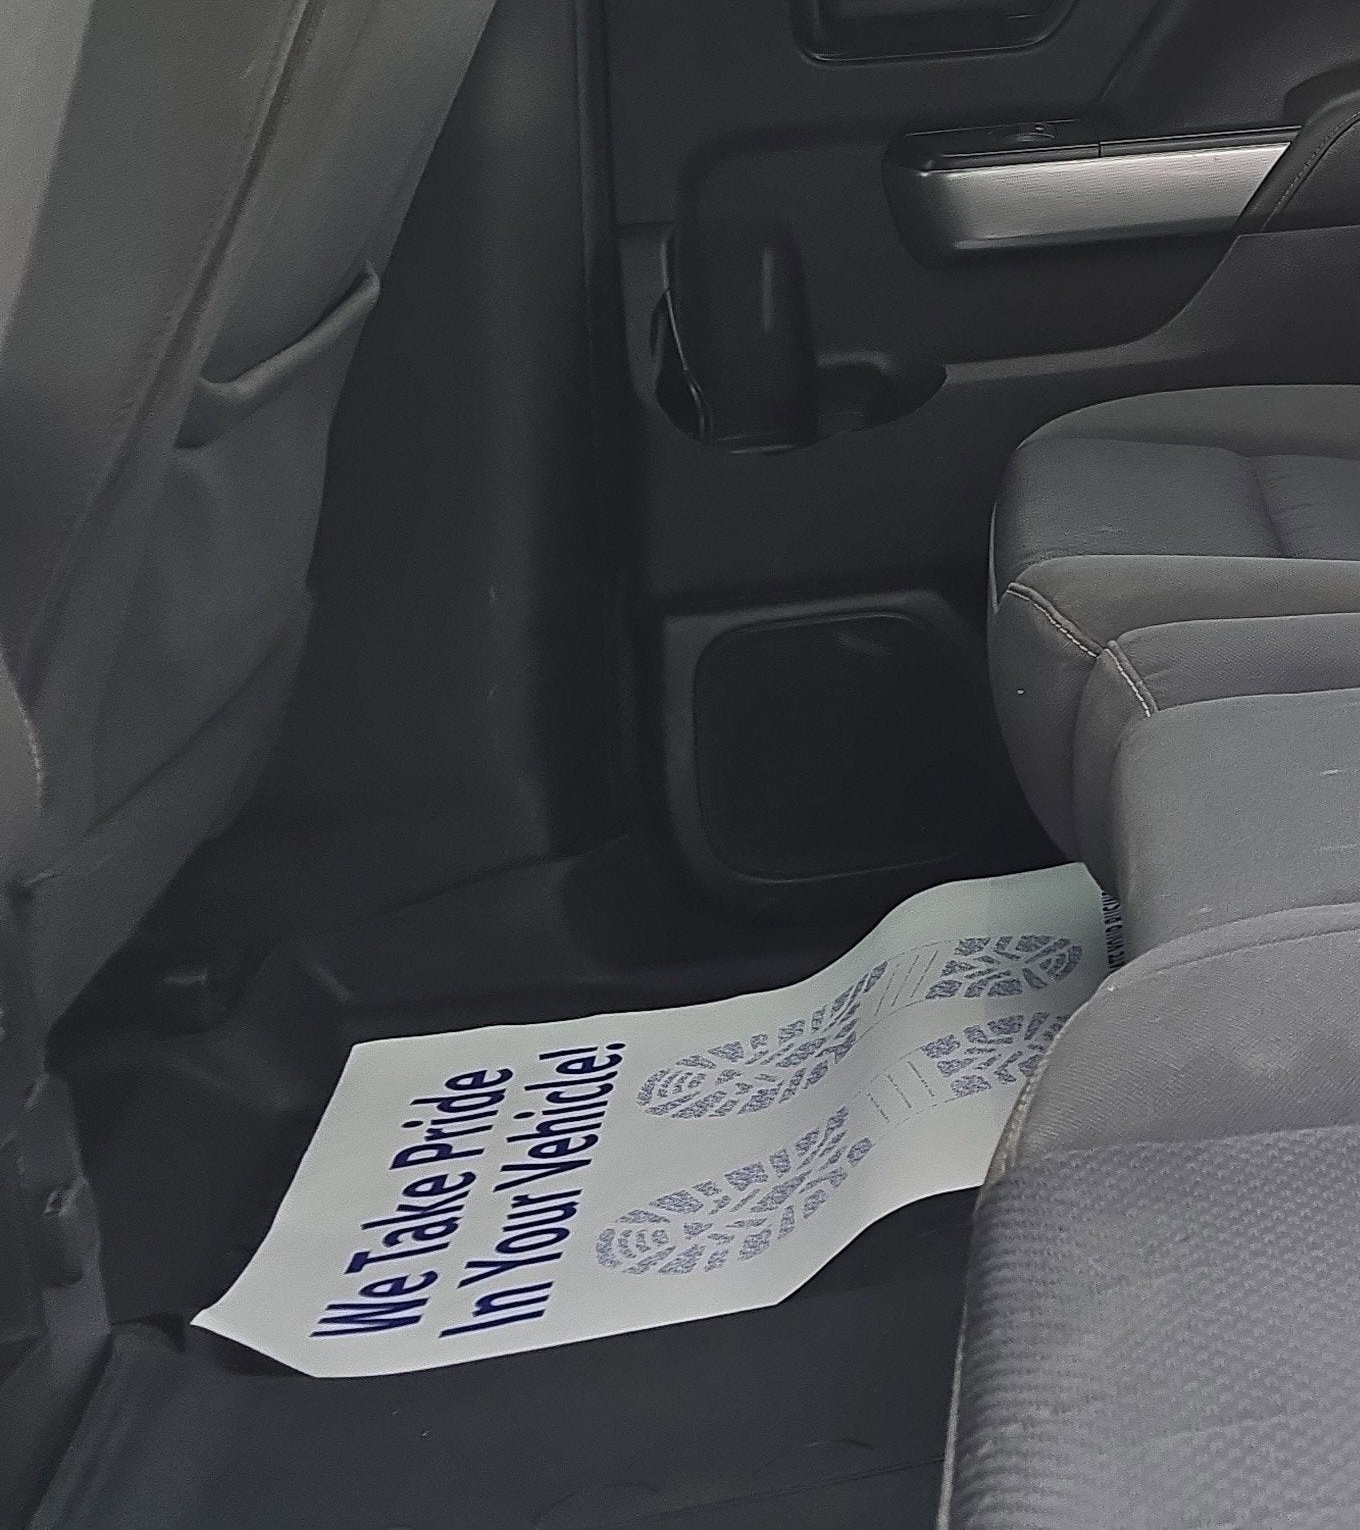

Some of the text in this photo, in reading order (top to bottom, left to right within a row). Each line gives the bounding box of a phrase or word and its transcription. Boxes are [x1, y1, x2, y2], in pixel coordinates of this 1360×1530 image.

[308, 1068, 514, 1338] We Take Pride
[438, 1042, 627, 1339] In Your Vehicle!
